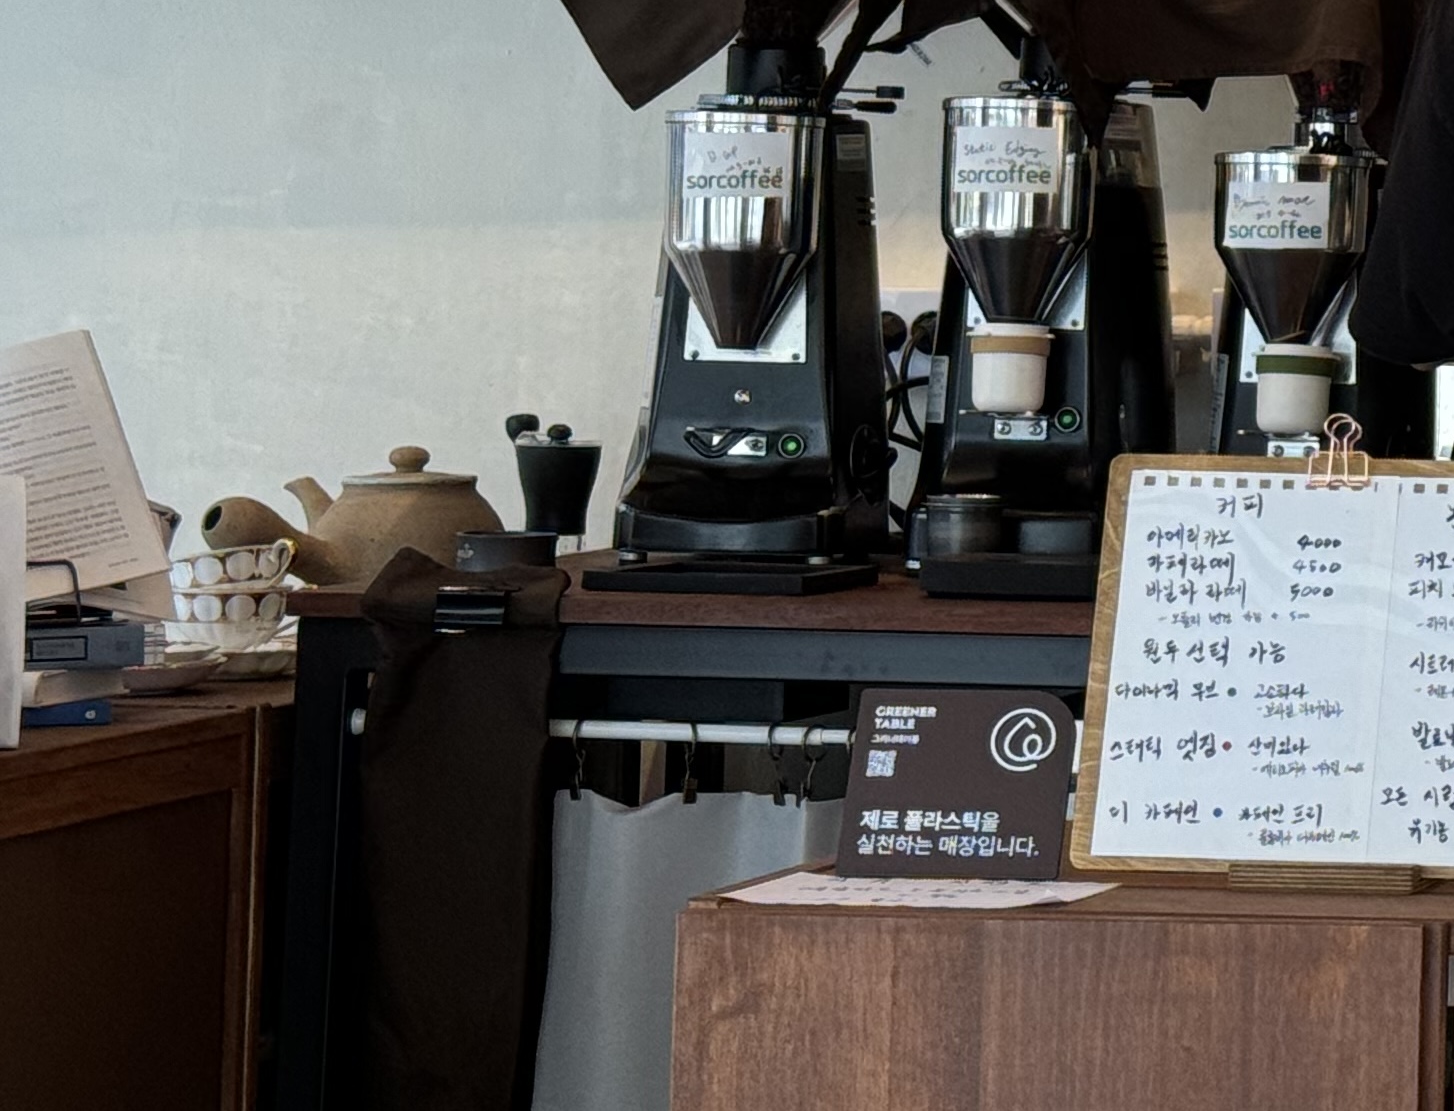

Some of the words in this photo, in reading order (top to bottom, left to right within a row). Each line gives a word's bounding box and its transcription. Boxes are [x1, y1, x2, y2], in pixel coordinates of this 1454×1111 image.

[686, 169, 783, 189] sorcoffee
[957, 164, 1052, 184] sorcoffee
[1228, 220, 1322, 239] sorcoffee
[1216, 493, 1264, 518] 커피
[1146, 522, 1234, 551] 아메리카노
[1296, 534, 1342, 551] 4000
[1292, 558, 1342, 575] 4500
[1289, 582, 1334, 602] 5000
[1408, 578, 1443, 600] 피치
[1248, 639, 1286, 665] 가능
[875, 706, 938, 718] GREENER
[874, 718, 916, 730] TABLE
[1379, 785, 1410, 808] 모든
[859, 809, 899, 830] 제로
[904, 809, 1001, 833] 플라스틱을
[857, 833, 934, 856] 실천하는
[938, 835, 1040, 858] 매장입니다.
